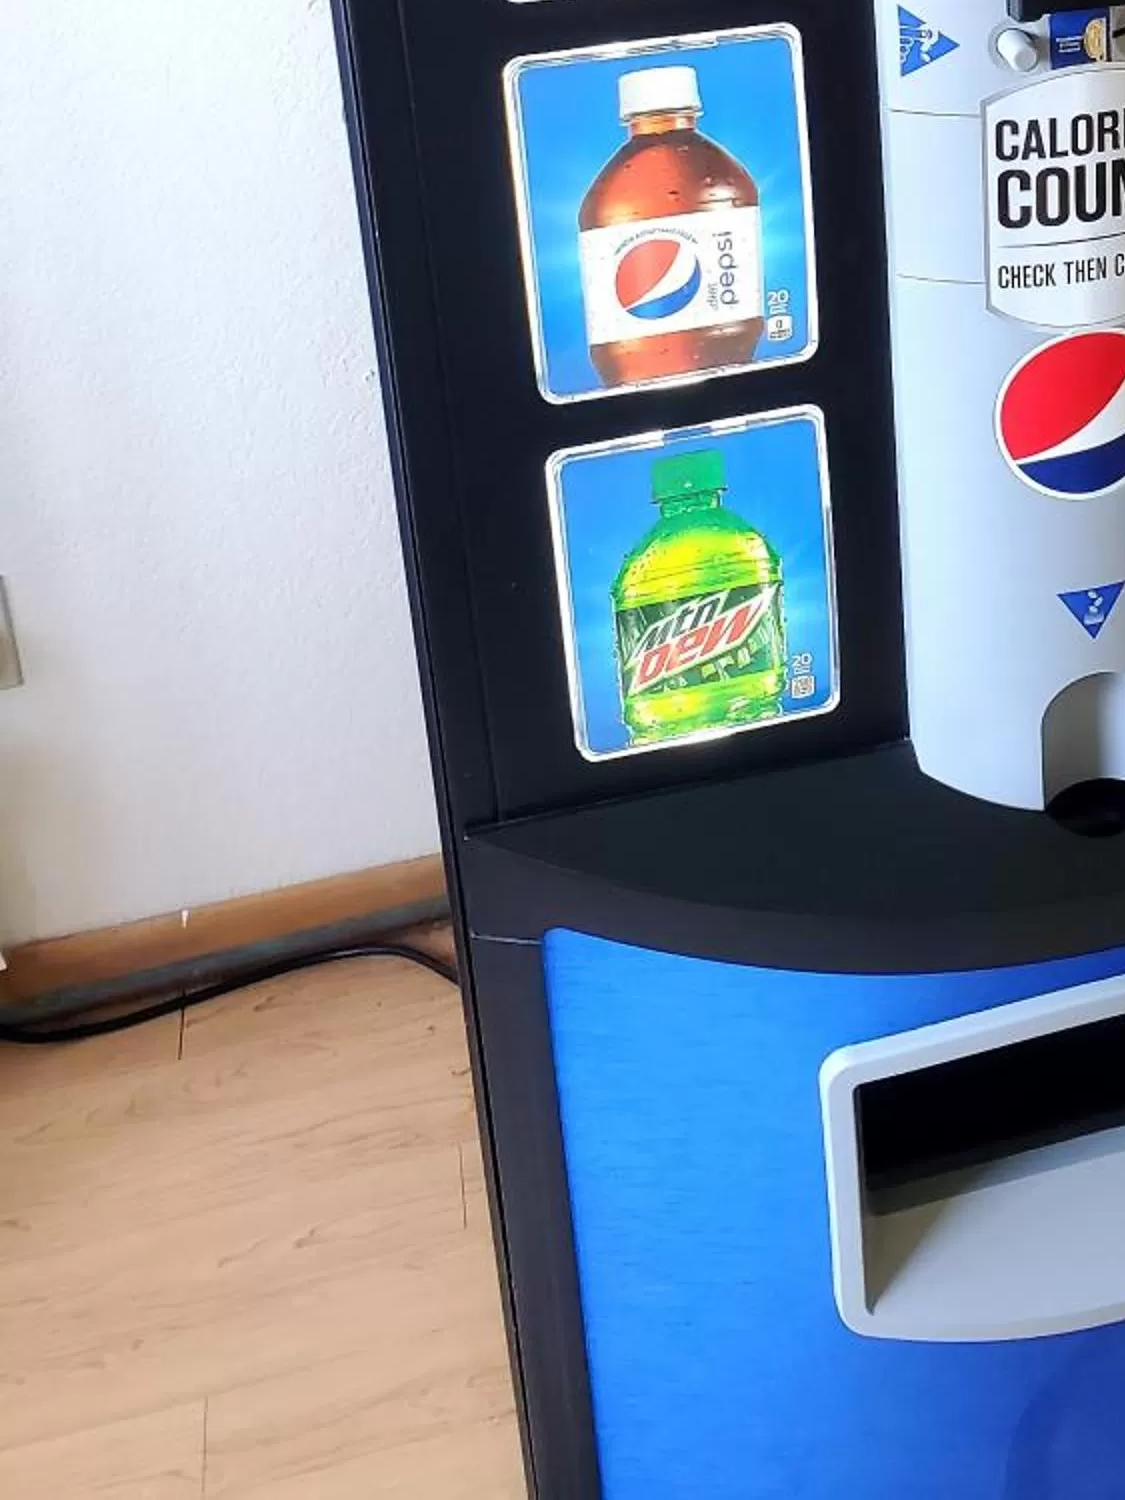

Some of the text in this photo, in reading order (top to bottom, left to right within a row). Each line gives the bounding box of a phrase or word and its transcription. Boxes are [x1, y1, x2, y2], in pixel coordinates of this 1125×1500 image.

[712, 230, 740, 306] pepsi
[997, 263, 1056, 290] CHECK
[1064, 255, 1107, 285] THEN
[767, 289, 789, 305] 20
[791, 653, 813, 667] 20
